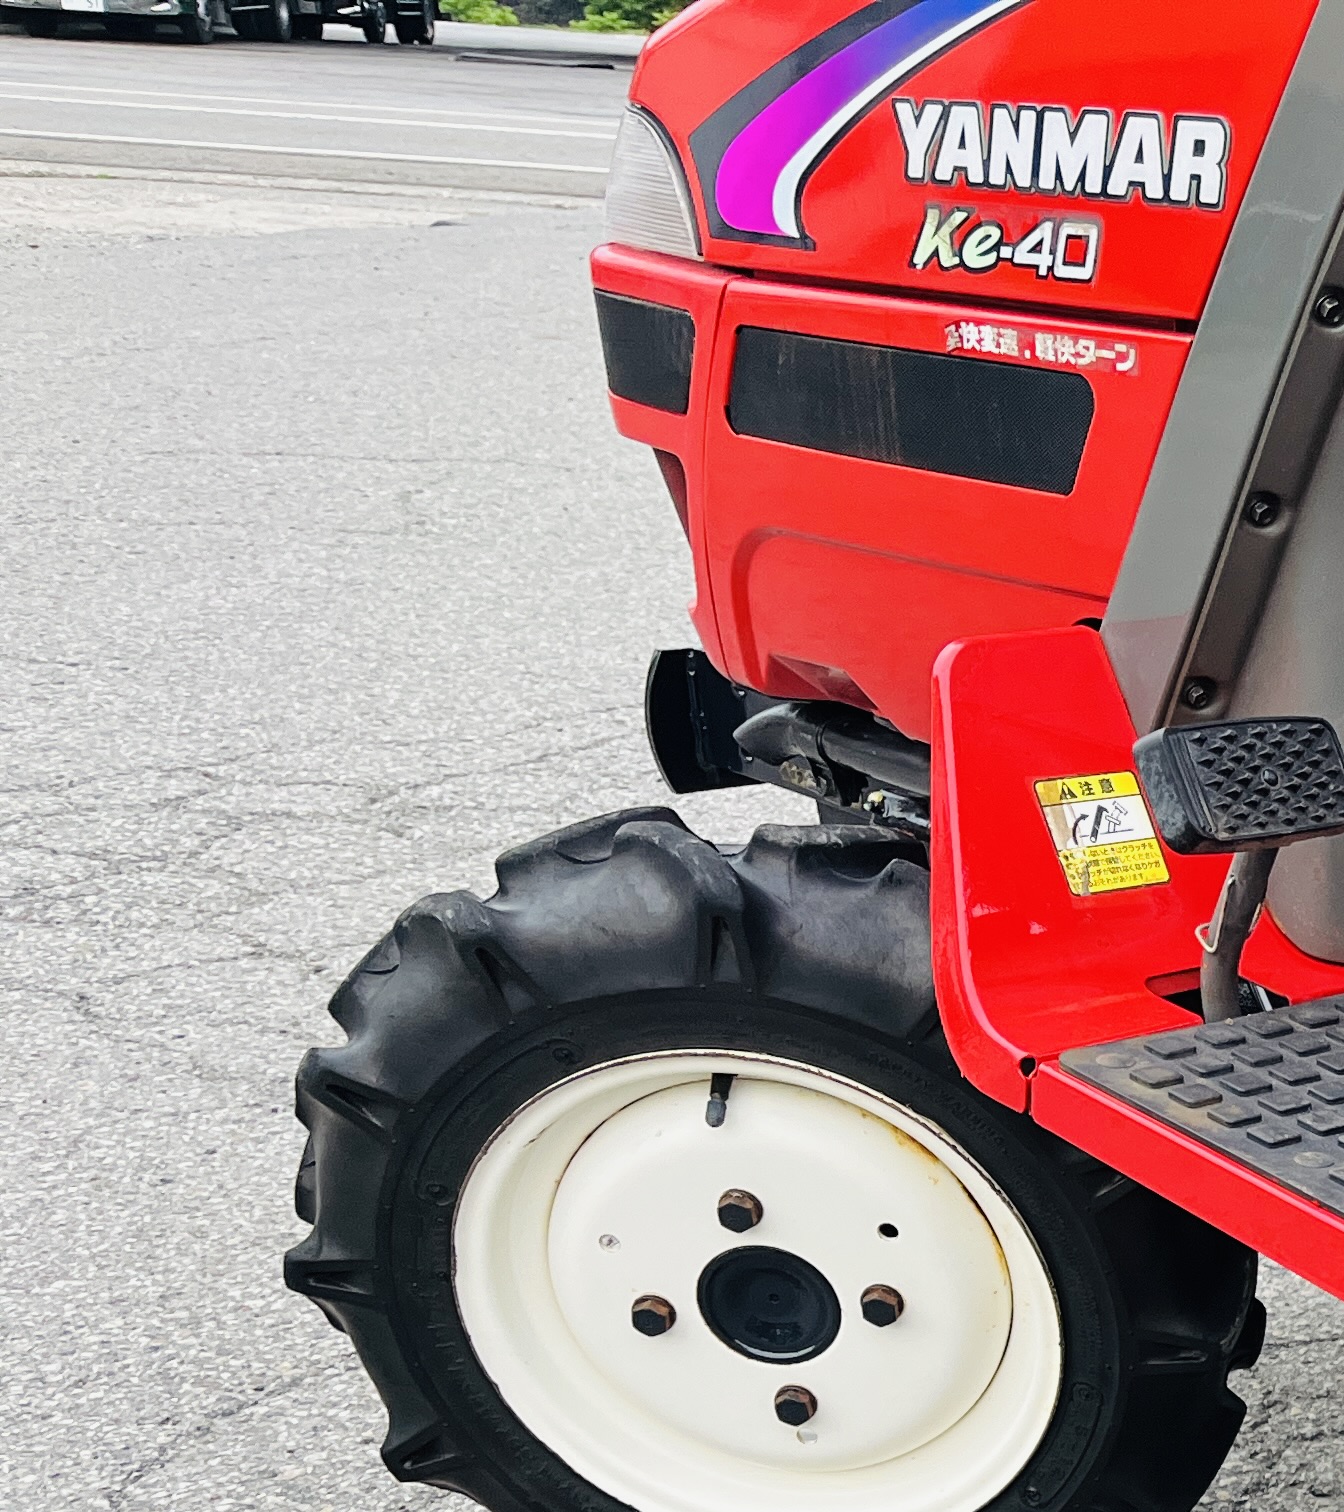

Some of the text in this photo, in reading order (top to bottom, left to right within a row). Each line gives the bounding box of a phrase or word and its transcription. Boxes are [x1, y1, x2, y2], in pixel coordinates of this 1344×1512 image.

[893, 98, 1230, 209] YANMAR
[912, 207, 1101, 283] Ke-40
[1079, 778, 1115, 796] 注意
